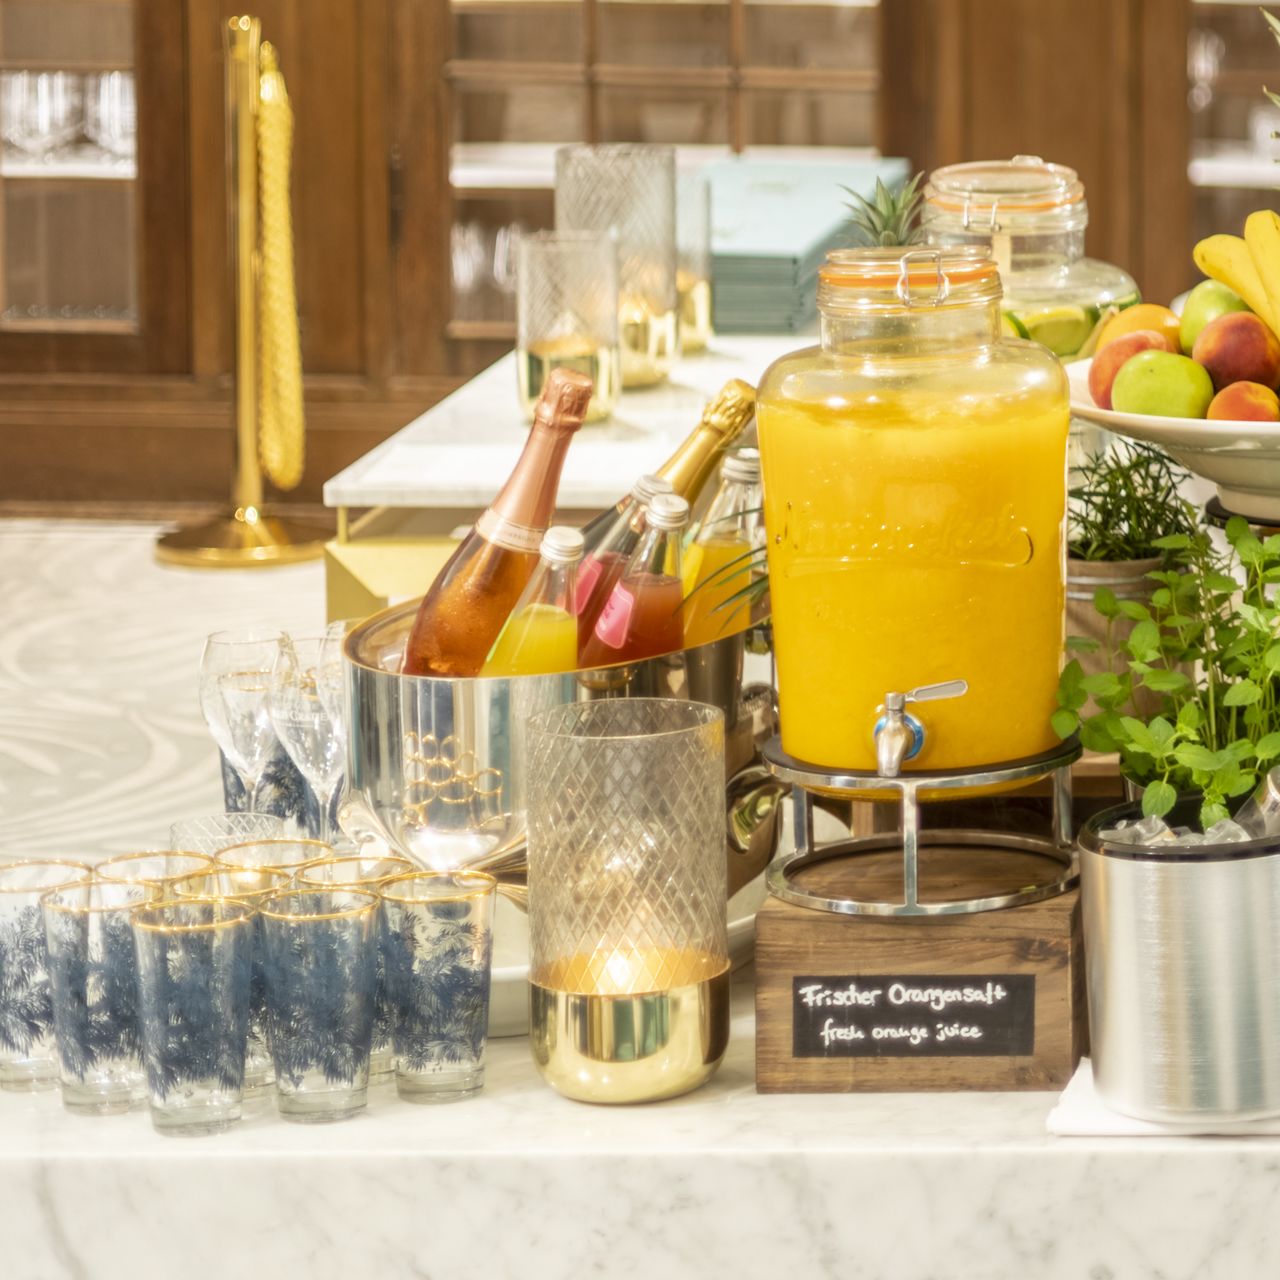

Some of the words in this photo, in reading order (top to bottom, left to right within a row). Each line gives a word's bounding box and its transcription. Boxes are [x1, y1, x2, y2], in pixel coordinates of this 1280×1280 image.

[799, 983, 882, 1007] Frischer
[820, 1018, 865, 1046] fresh
[872, 1027, 928, 1045] orange
[936, 1023, 983, 1042] juice
